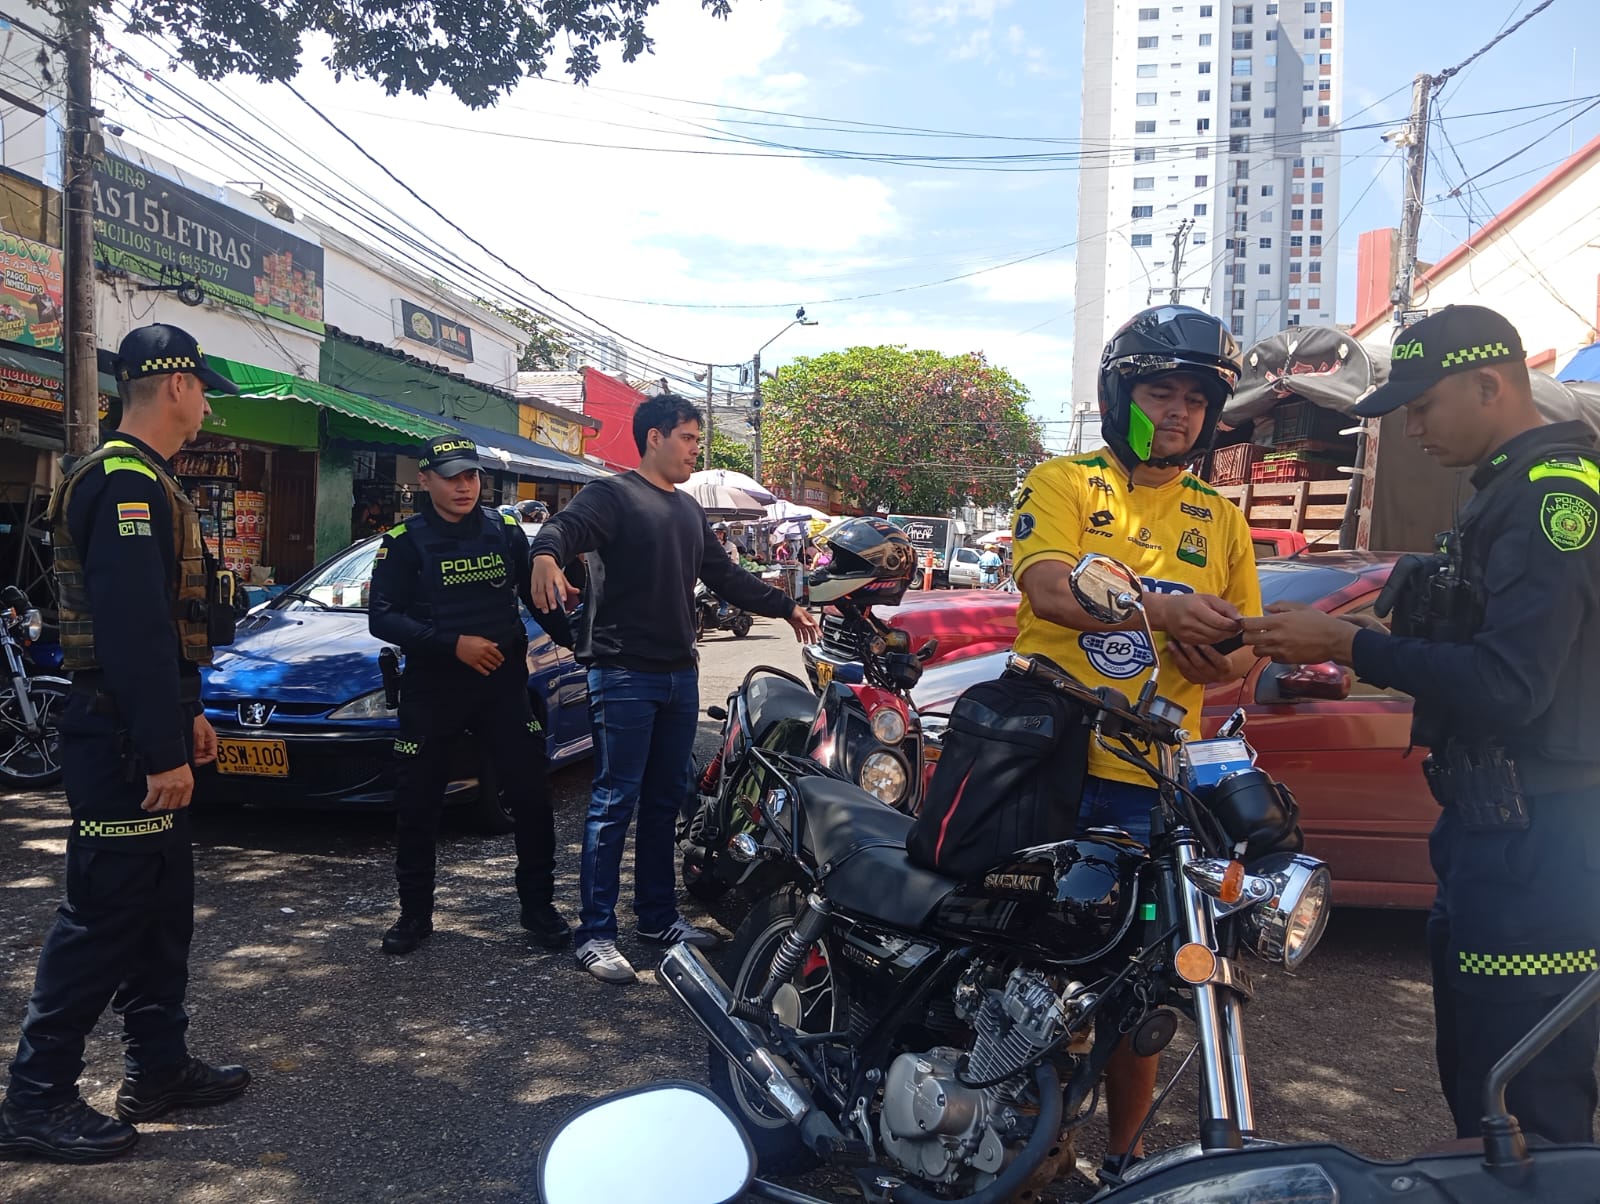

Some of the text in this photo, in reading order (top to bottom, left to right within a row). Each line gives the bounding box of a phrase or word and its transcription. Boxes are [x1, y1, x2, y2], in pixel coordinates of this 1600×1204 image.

[153, 240, 176, 263] Tel:
[1105, 642, 1132, 655] BB
[105, 821, 161, 835] POLICÍA
[983, 874, 1042, 891] SUZUKI
